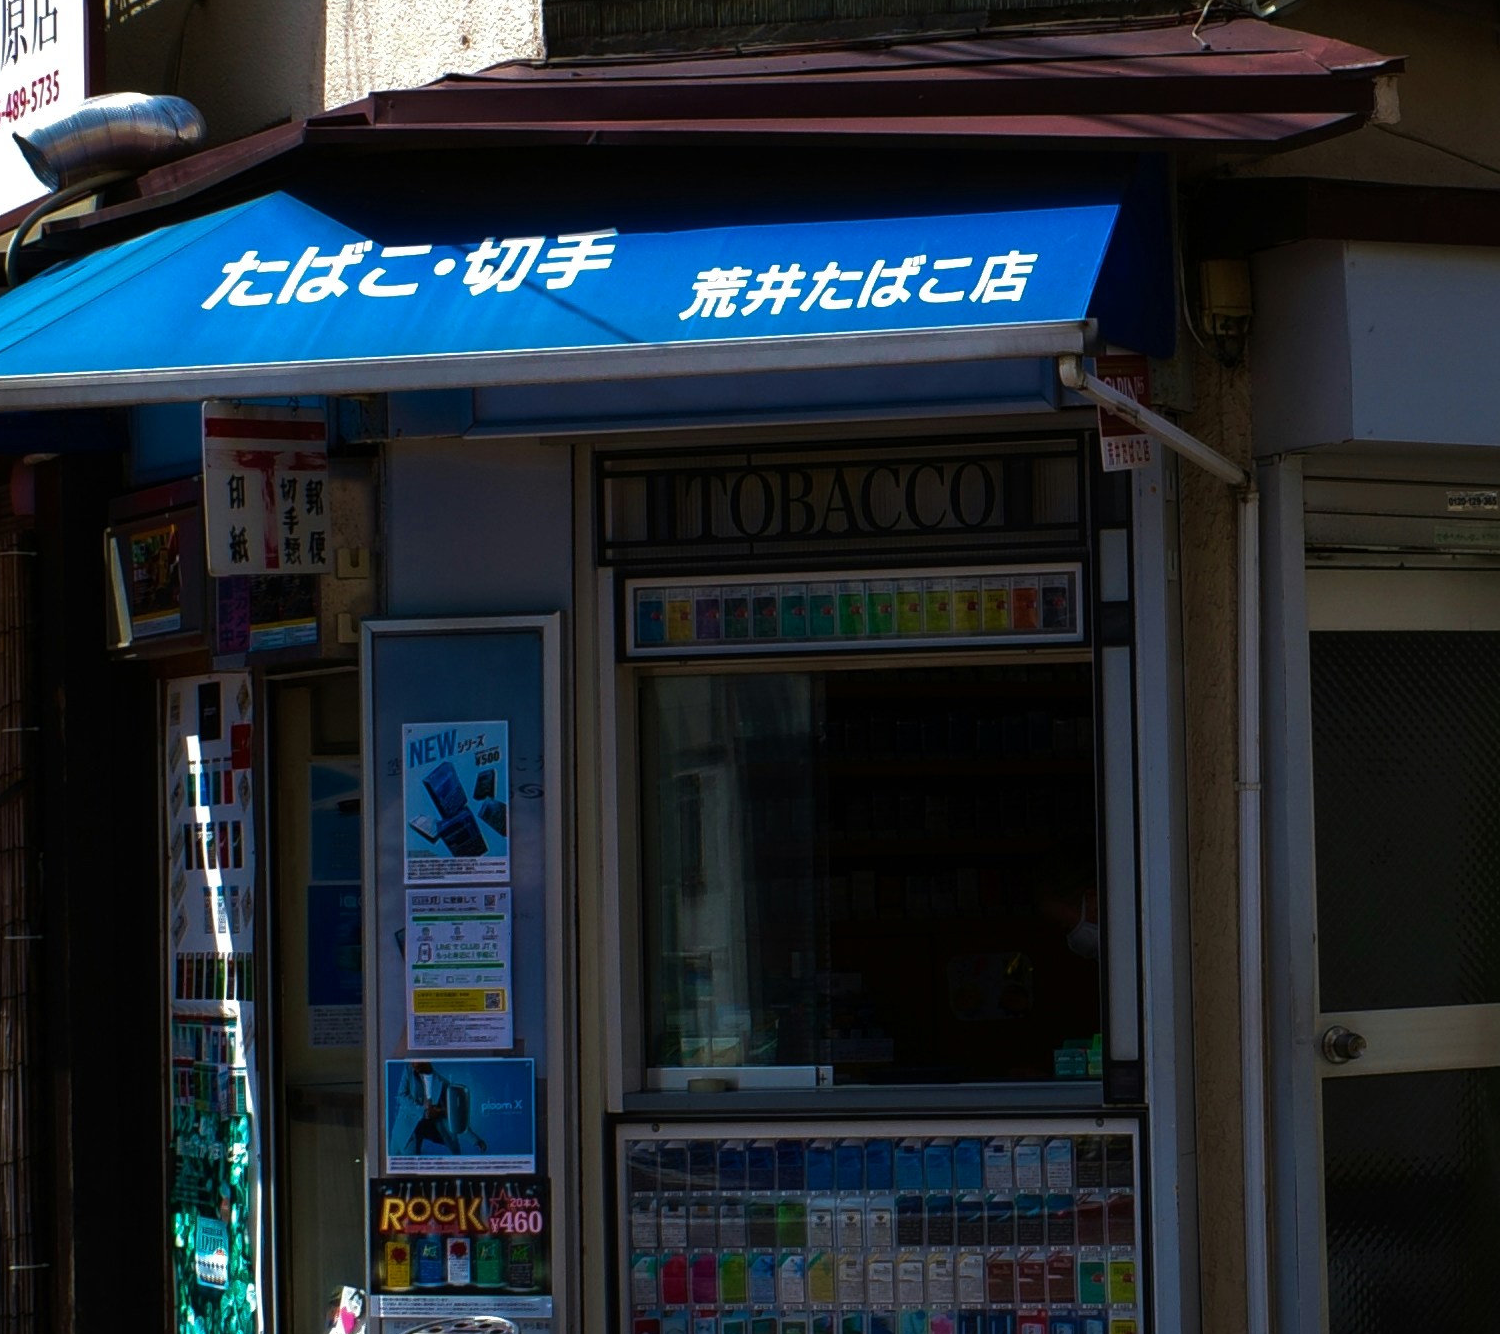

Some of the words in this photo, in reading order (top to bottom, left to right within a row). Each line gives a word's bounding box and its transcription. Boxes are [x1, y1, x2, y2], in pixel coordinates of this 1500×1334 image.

[202, 226, 620, 310] たばこ・切手
[678, 249, 1041, 324] 荒井たばこ店
[227, 474, 250, 564] 印紙
[280, 477, 303, 565] 切手類
[305, 478, 327, 565] 郵便
[685, 461, 996, 541] TOBACCO
[409, 729, 457, 768] NEW
[475, 750, 500, 766] ¥500
[379, 1195, 488, 1234] ROCK
[490, 1210, 544, 1234] ¥460
